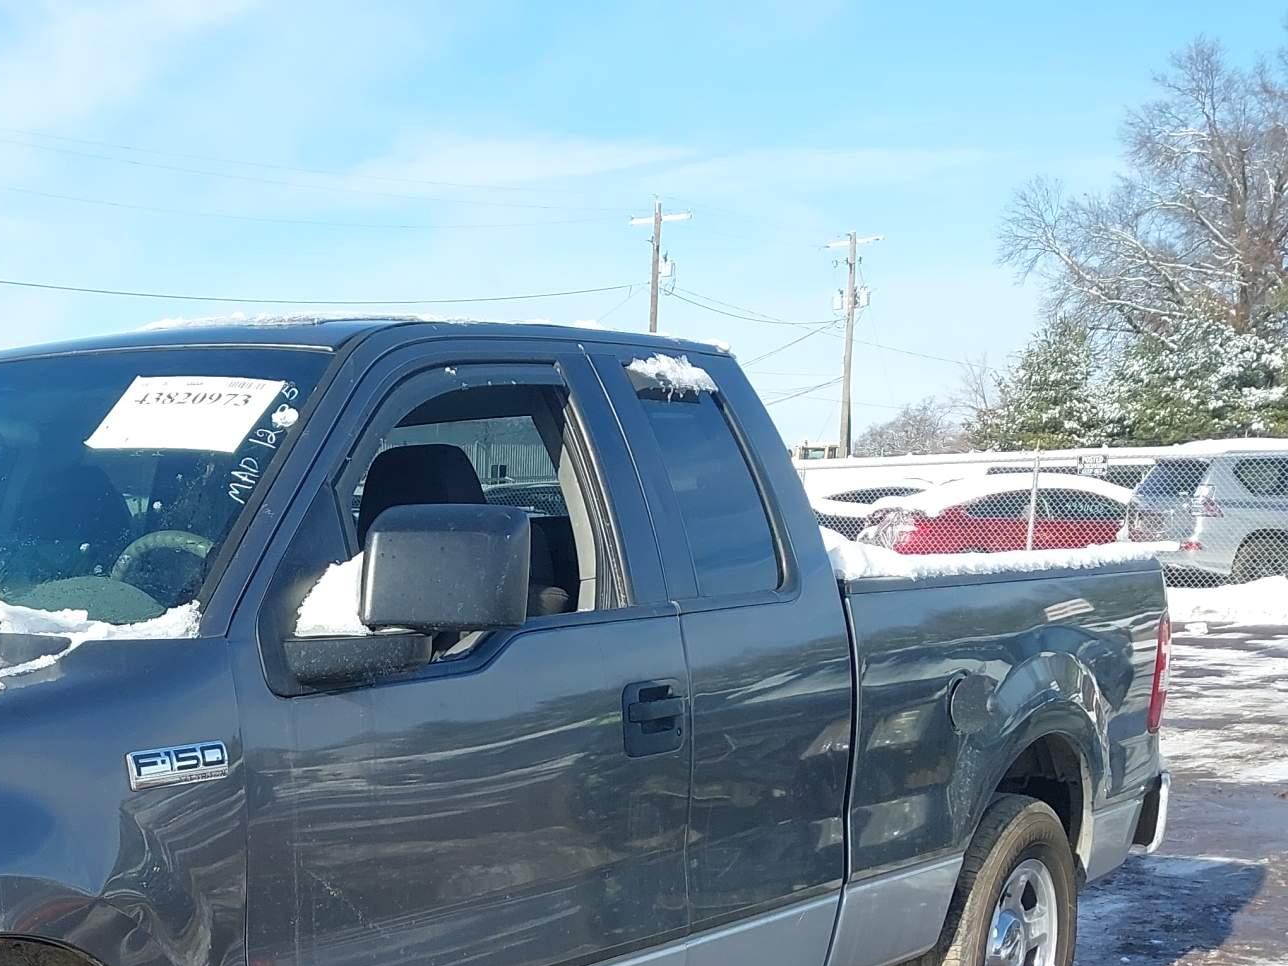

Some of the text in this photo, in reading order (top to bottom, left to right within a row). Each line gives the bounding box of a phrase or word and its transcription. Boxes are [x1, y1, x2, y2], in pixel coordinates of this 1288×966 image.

[134, 392, 252, 407] 43820973
[228, 457, 260, 504] MAD
[248, 429, 284, 449] 12
